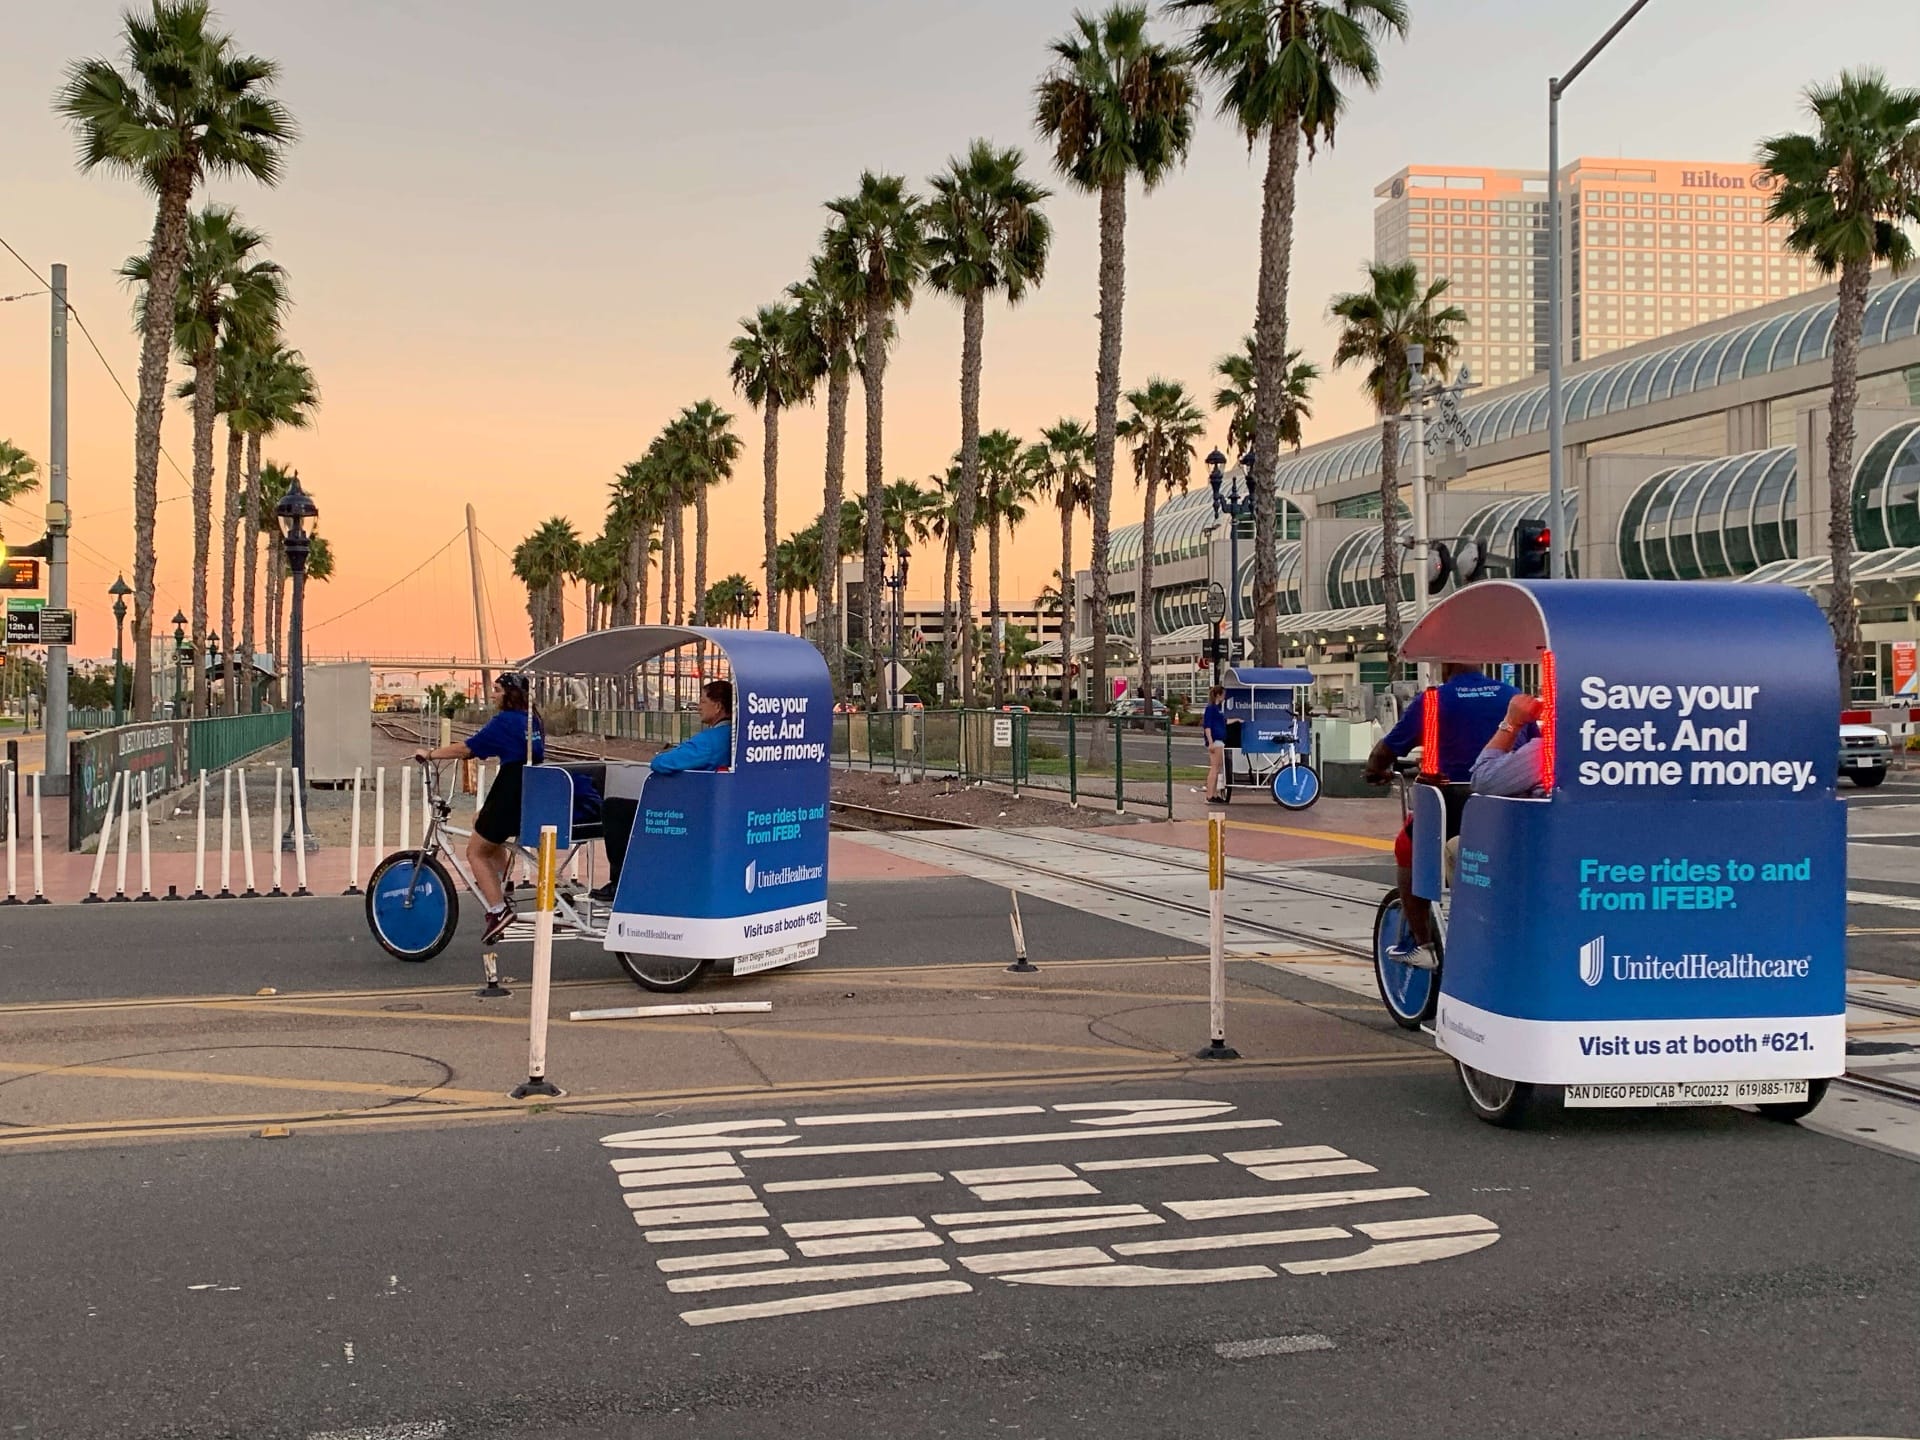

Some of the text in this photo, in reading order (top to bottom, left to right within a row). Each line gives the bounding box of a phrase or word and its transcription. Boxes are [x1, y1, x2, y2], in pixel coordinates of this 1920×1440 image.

[1682, 165, 1745, 189] Hilton
[1427, 367, 1468, 455] CROSSIG
[7, 632, 39, 640] Imperia
[748, 692, 808, 718] Save your
[1580, 677, 1760, 717] Save your
[747, 718, 805, 741] feet. And
[1579, 719, 1748, 752] feet. And
[745, 743, 825, 763] some money.
[1578, 760, 1817, 792] some money.
[645, 817, 669, 826] to and
[646, 809, 684, 819] Free rides
[747, 804, 825, 827] Free rides to and
[645, 825, 663, 834] from
[747, 824, 801, 845] from IFEBP.
[757, 865, 823, 888] UnitedHealthcare
[1579, 858, 1811, 883] Free rides to and
[1579, 886, 1737, 911] from IFEBP.
[626, 927, 684, 942] UnitedHealthcare
[744, 922, 762, 938] Visit
[764, 924, 773, 935] us
[774, 919, 783, 932] at
[784, 913, 805, 930] booth
[1612, 953, 1809, 981] UnitedHealthcare
[1579, 1032, 1814, 1056] Visit us at booth #621.
[1567, 1081, 1807, 1099] SAN DIEGO PEDICAB PC00232 (619)885-1782
